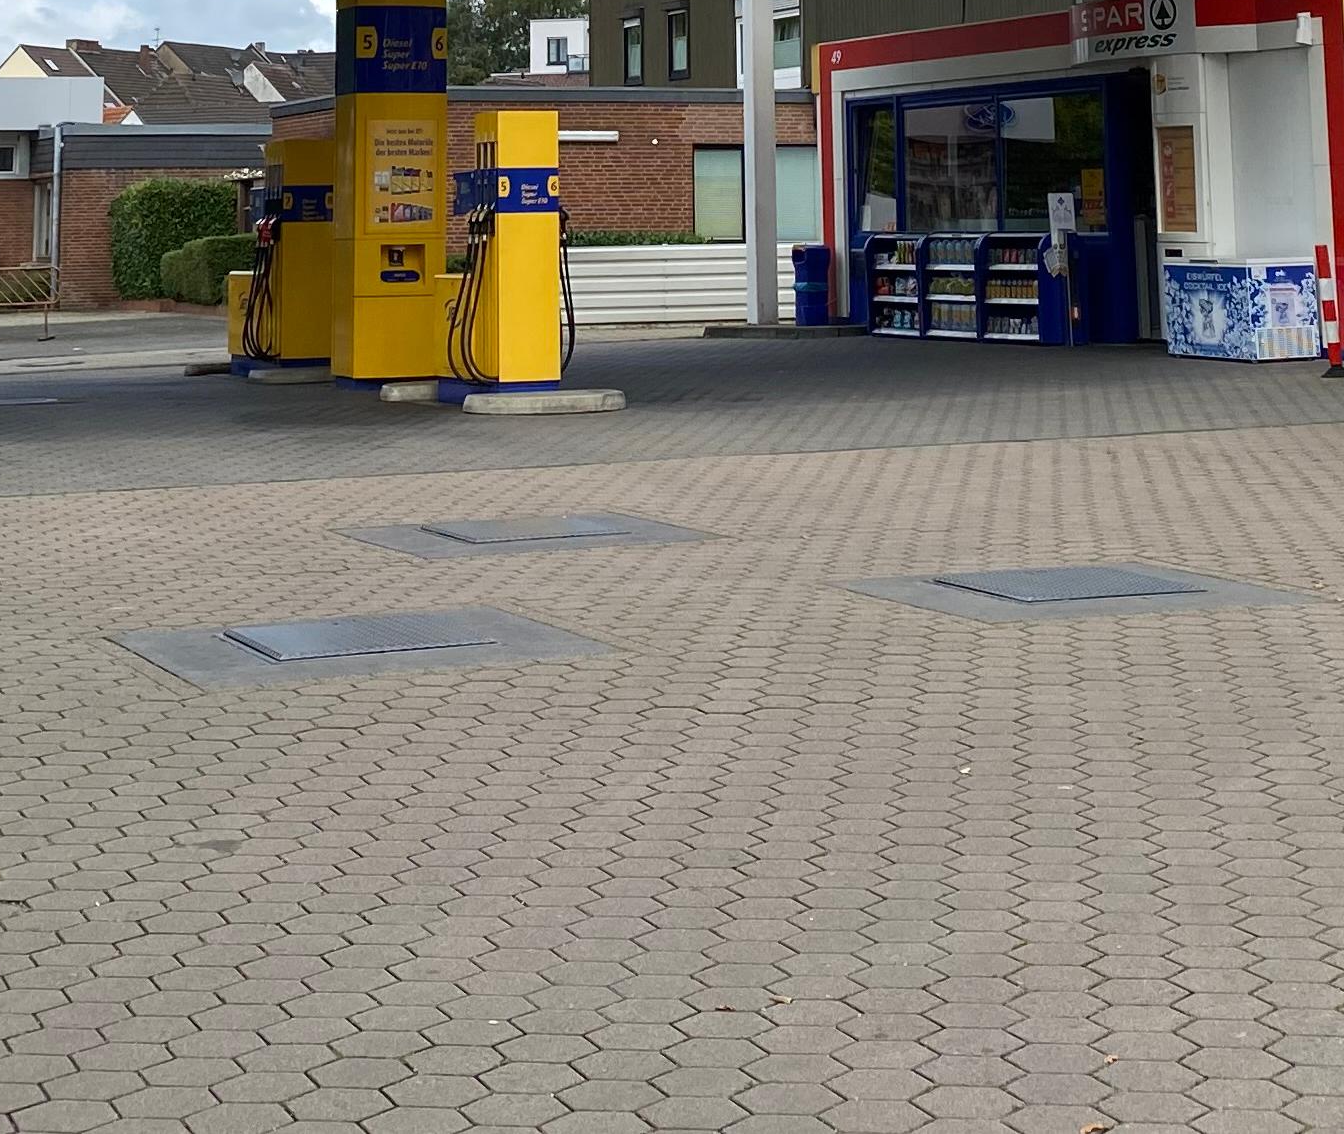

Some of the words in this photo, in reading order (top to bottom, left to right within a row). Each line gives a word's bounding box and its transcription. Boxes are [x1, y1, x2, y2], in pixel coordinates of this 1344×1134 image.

[363, 34, 373, 50] 5
[383, 38, 413, 48] Diesel
[435, 36, 444, 51] 6
[1094, 33, 1177, 56] express
[382, 50, 411, 60] Super
[501, 181, 507, 192] 5
[550, 180, 558, 192] 6
